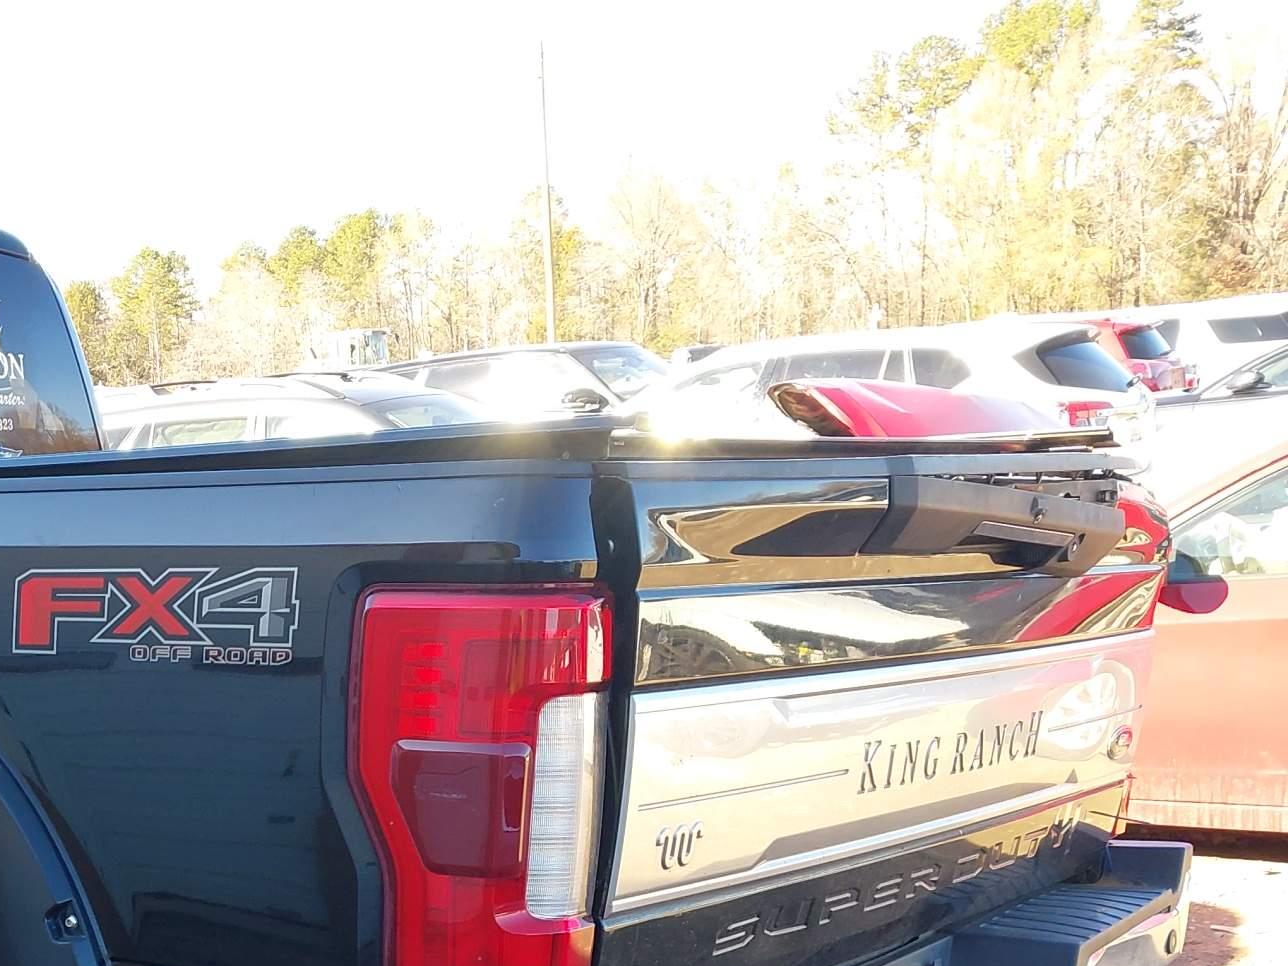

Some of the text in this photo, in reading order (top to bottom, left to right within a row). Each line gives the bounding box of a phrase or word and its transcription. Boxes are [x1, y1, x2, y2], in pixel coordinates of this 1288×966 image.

[12, 567, 300, 655] FX4
[129, 644, 293, 665] OFF ROAD
[857, 709, 1044, 795] KING RANCH
[713, 802, 1087, 956] SUPER DUTY
